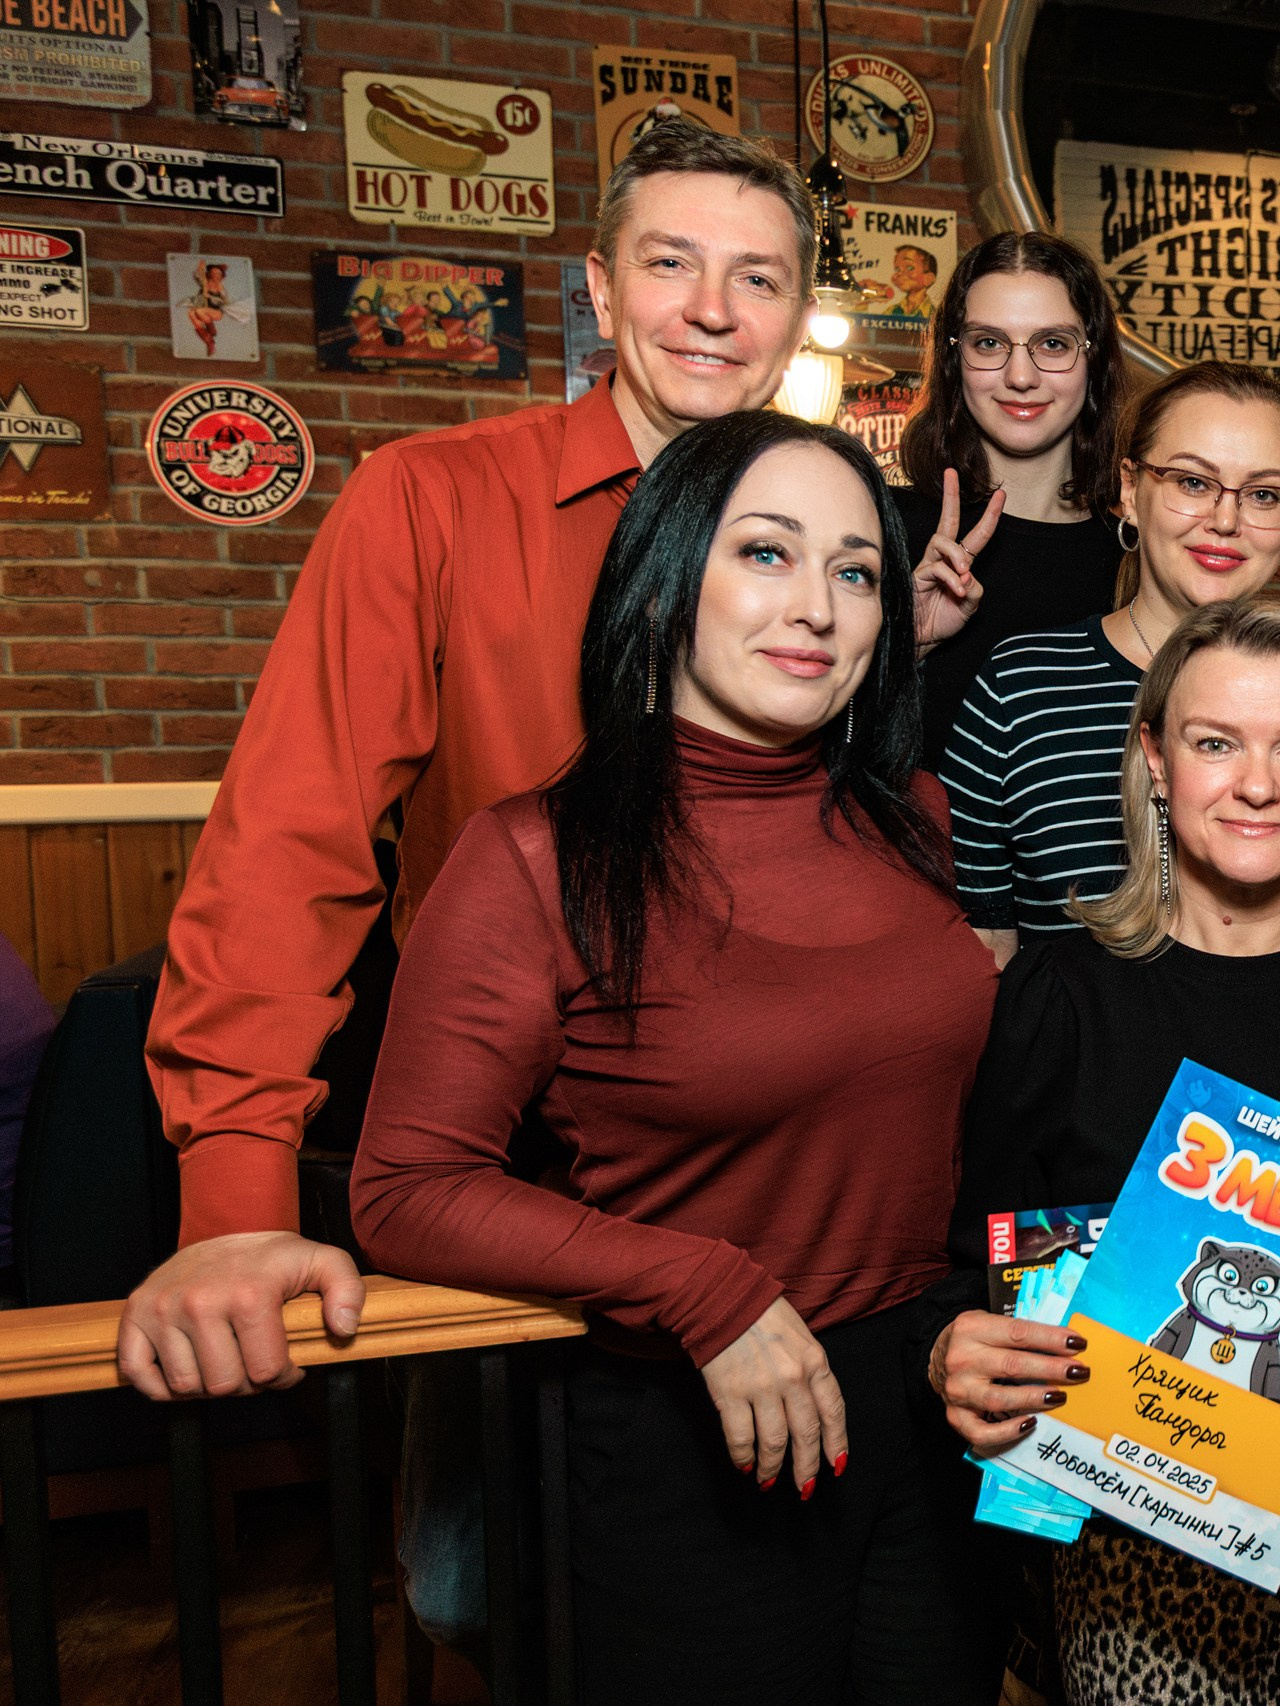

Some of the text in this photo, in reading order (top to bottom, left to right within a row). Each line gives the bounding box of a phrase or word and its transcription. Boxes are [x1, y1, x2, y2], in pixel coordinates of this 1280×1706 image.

[32, 0, 127, 37] BEACH
[34, 50, 141, 73] PROHIBITED
[599, 64, 734, 117] SUNDAE
[22, 135, 81, 155] New
[92, 142, 199, 166] Orleans
[105, 159, 275, 206] Quarter
[355, 169, 550, 218] HOT DOGS
[11, 264, 76, 278] INCREASE
[337, 255, 505, 286] BIG DIPPER
[29, 306, 77, 321] SHOT
[162, 390, 297, 438] UNIVERSITY
[164, 441, 297, 465] BULL DOGS
[170, 469, 300, 515] OF GEORGIA
[1163, 1117, 1230, 1193] 3
[1135, 1392, 1227, 1449] Пандоры
[1115, 1440, 1213, 1495] 02.04.2025
